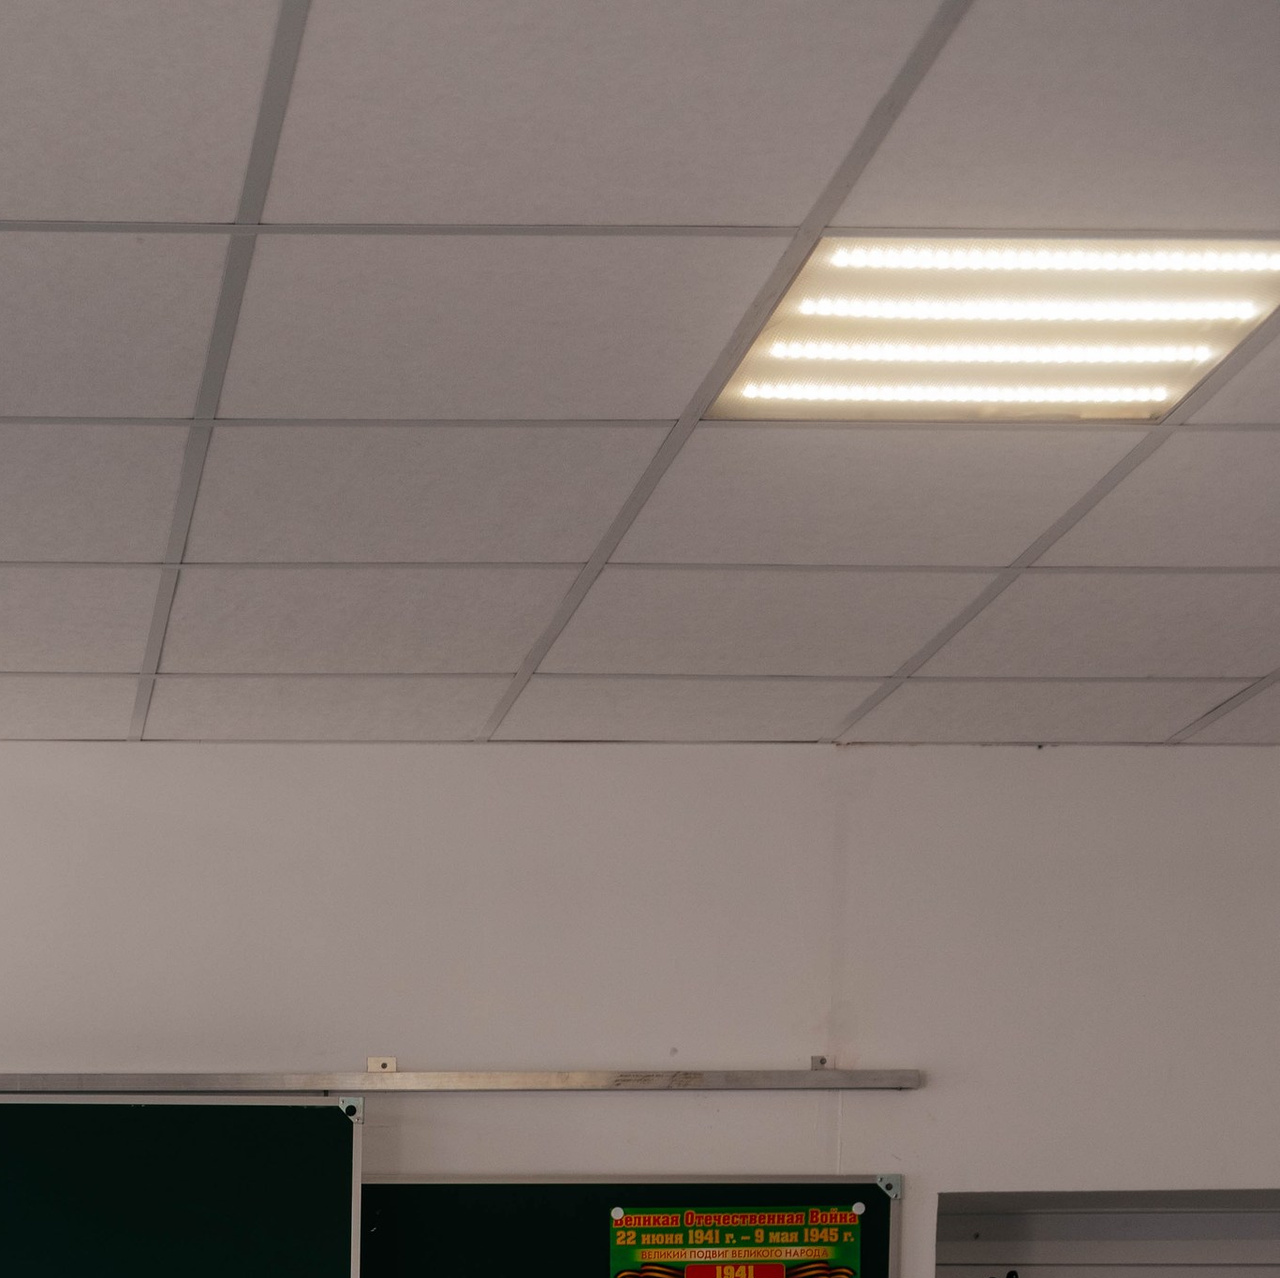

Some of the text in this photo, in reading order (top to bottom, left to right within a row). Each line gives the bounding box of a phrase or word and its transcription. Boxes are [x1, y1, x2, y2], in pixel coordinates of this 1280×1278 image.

[684, 1210, 805, 1227] Отечественная
[809, 1207, 859, 1225] Война
[616, 1230, 636, 1245] 22
[641, 1233, 684, 1245] июня
[688, 1229, 720, 1245] 1941
[725, 1233, 737, 1244] г.
[754, 1228, 765, 1243] 9
[769, 1231, 799, 1243] мая
[803, 1227, 839, 1243] 1945
[843, 1231, 855, 1242] г.
[641, 1248, 829, 1260] ВЕЛИКИЙ ПОДВИГ ВЕЛИКОГО НАРОДА
